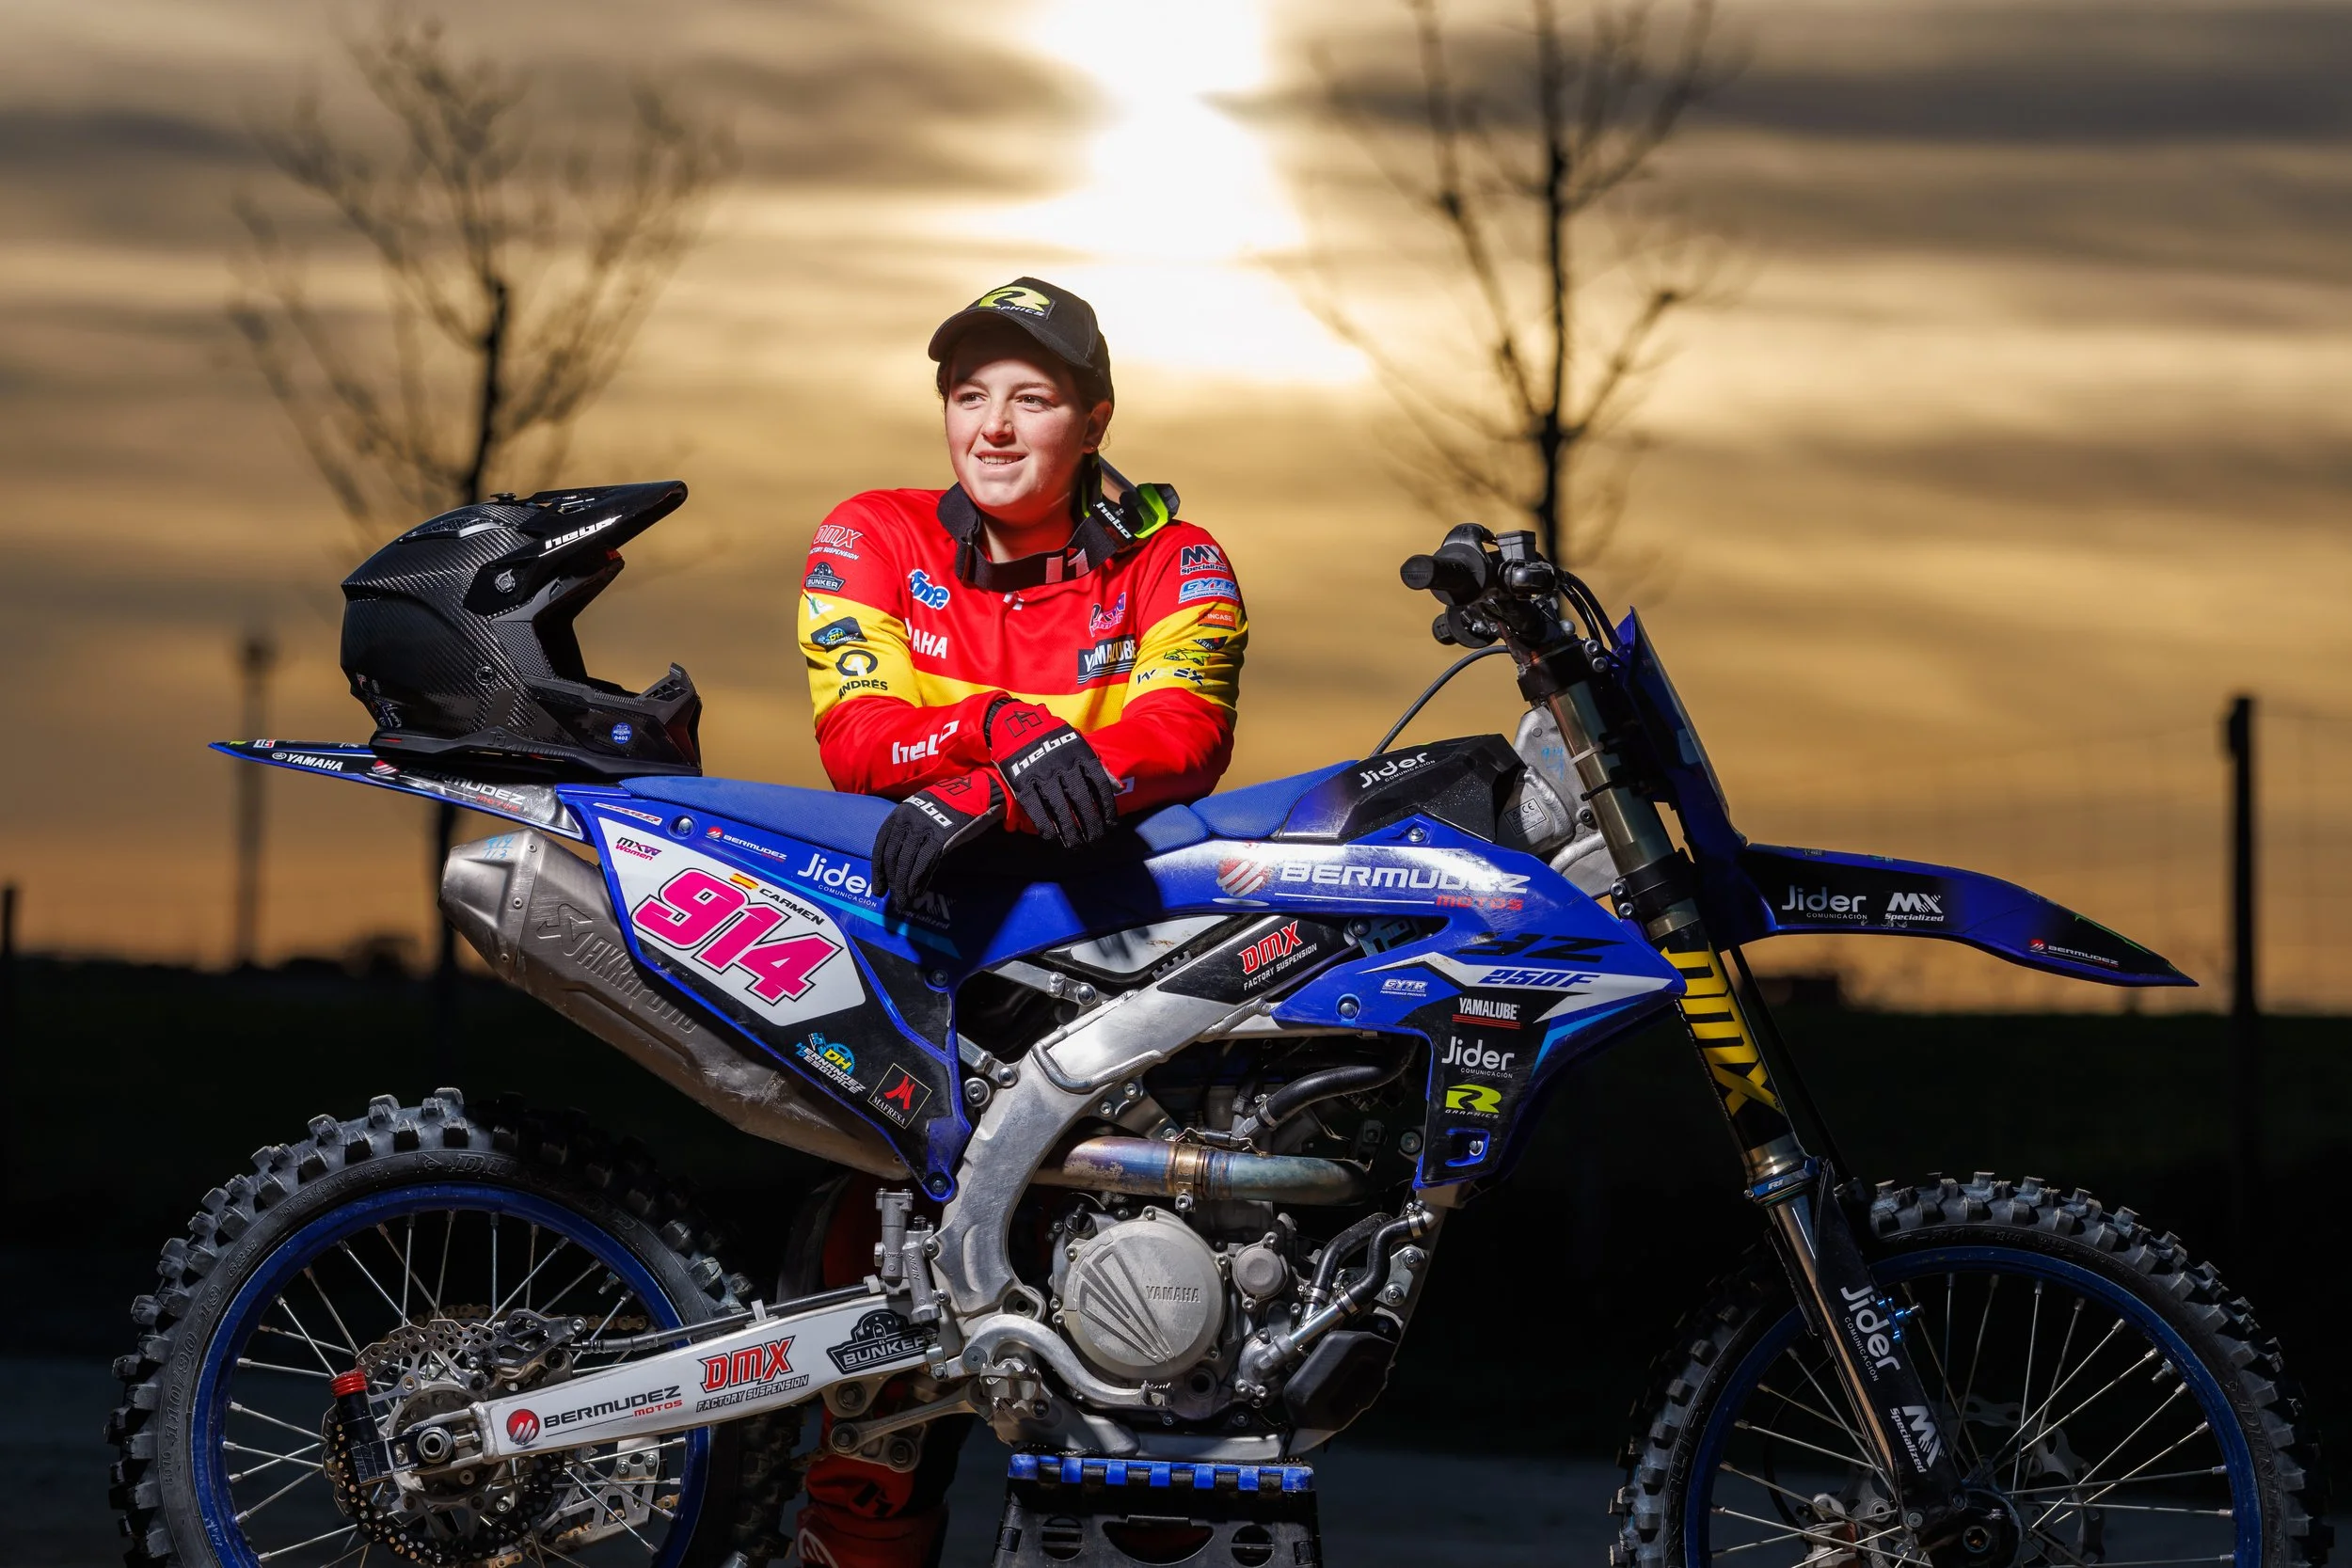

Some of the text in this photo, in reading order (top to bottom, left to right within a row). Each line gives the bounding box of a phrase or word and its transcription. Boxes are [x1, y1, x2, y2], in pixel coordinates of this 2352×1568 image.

[546, 515, 622, 549] hebo
[1096, 501, 1133, 539] hebo
[905, 617, 948, 659] AHA
[838, 679, 888, 700] ANDRÉS
[287, 753, 343, 772] YAMAHA
[1009, 731, 1078, 778] hebo
[1359, 752, 1427, 788] Jider
[615, 844, 654, 861] Women
[723, 833, 787, 861] BERMUDEZ
[1280, 863, 1532, 895] BERMUDZ
[759, 887, 826, 927] CARMEN
[818, 883, 878, 909] COMUNICACIÓN
[1436, 894, 1524, 911] MOTOS
[1781, 884, 1867, 913] Jider
[1806, 911, 1868, 921] COMUNICACIÓN
[1884, 912, 1945, 922] Specialized
[631, 867, 844, 1006] 914
[1237, 920, 1304, 975] DMX
[1243, 942, 1318, 991] FACTORY SUSPENSION
[2047, 944, 2120, 966] BERMUDEZ
[1383, 978, 1429, 990] GYTR
[1477, 969, 1602, 988] 250F
[823, 1049, 853, 1071] DH
[1441, 1036, 1515, 1070] Jider
[1460, 1067, 1514, 1079] COMUNICACIÓN
[871, 1095, 906, 1126] MAFRESA
[1444, 1109, 1500, 1119] GRAPHICS
[1146, 1285, 1201, 1304] YAMAHA
[1840, 1285, 1901, 1372] Jider
[696, 1334, 797, 1393] DMX
[1844, 1316, 1880, 1383] COMUNICACIÓN
[544, 1385, 681, 1429] BERMUDEZ
[633, 1399, 683, 1418] MOTOS
[696, 1373, 810, 1413] FACTORY SUSPENSION
[1889, 1406, 1927, 1474] Specialized
